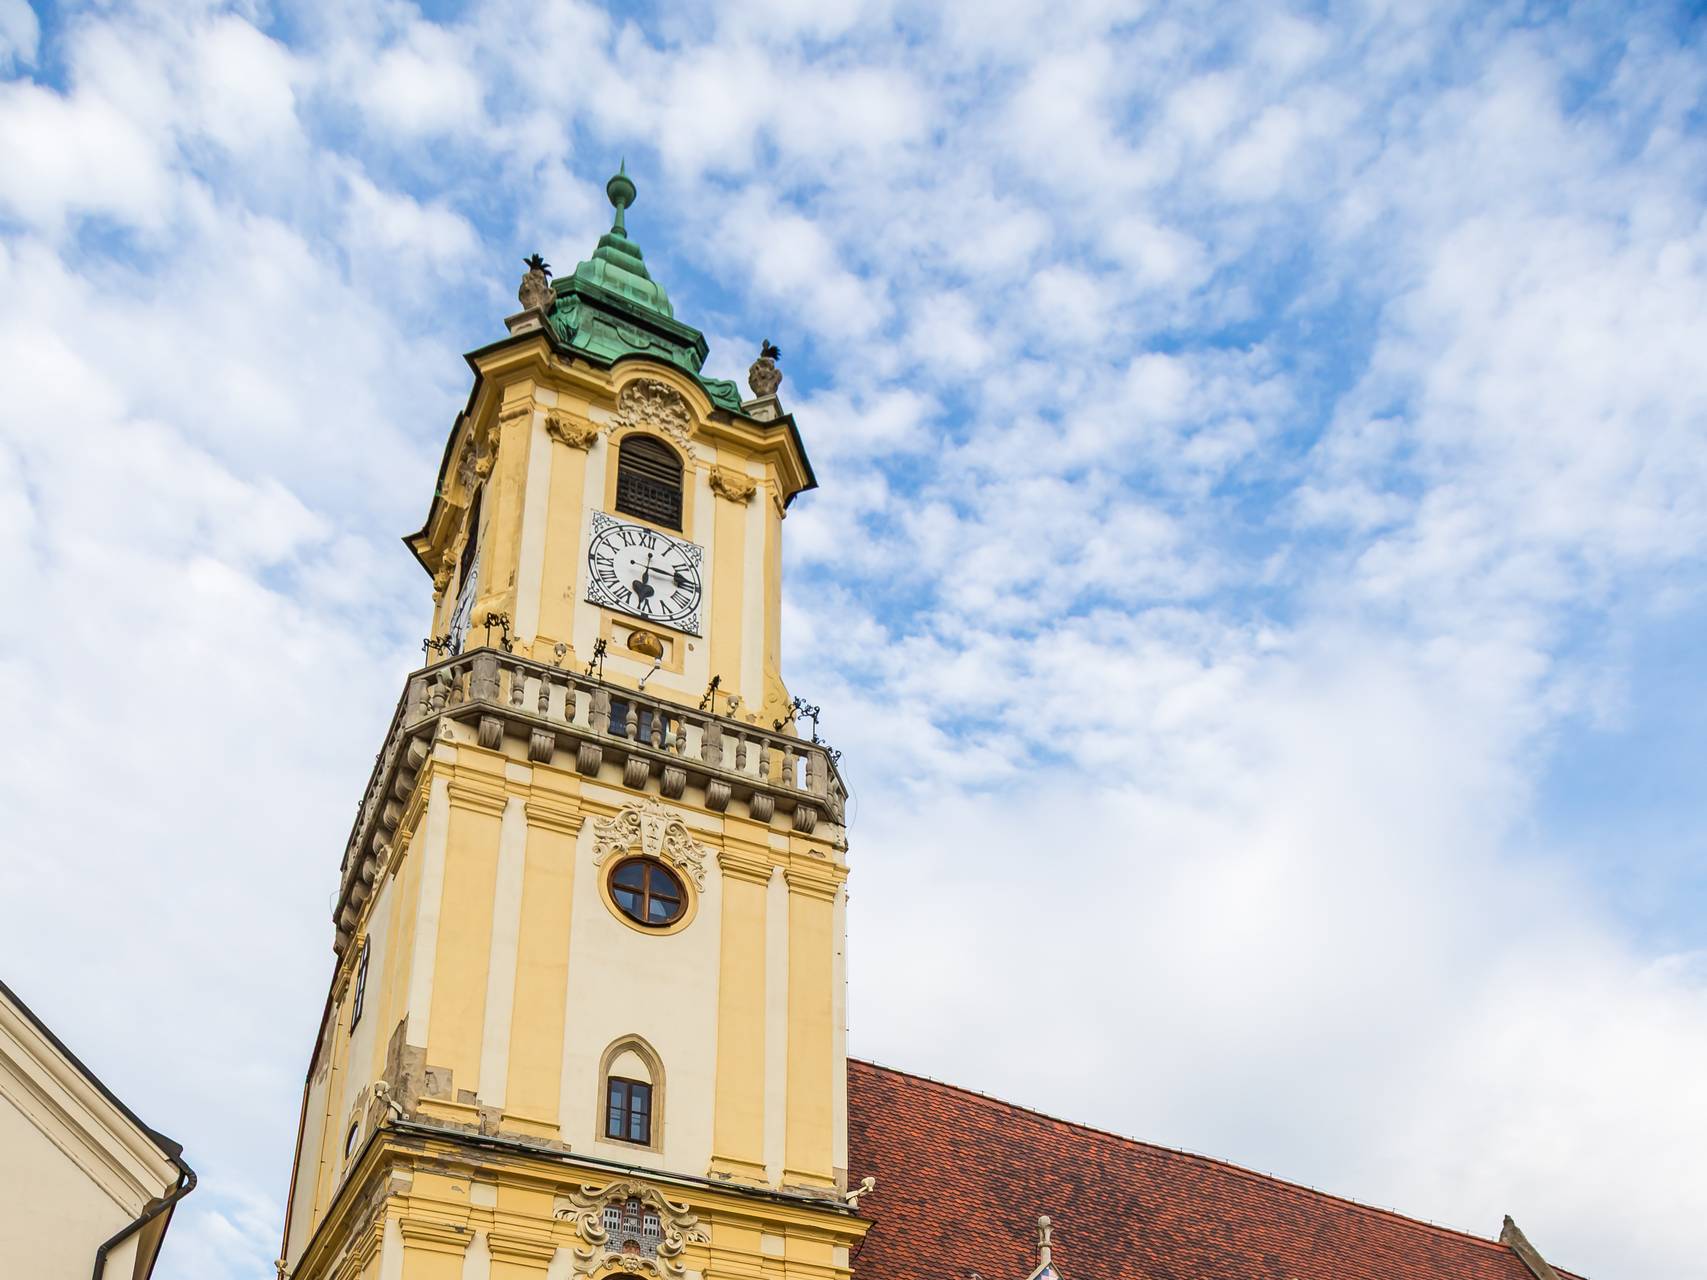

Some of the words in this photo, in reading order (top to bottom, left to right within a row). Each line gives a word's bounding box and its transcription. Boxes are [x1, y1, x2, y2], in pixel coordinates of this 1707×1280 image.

[602, 538, 620, 554] X
[617, 531, 636, 547] XI
[639, 532, 656, 550] XII
[597, 552, 614, 567] IX
[661, 547, 672, 557] I
[672, 563, 689, 572] II
[598, 569, 620, 589] VIII
[613, 585, 632, 604] VII
[671, 590, 690, 609] IIII
[660, 600, 673, 614] V
